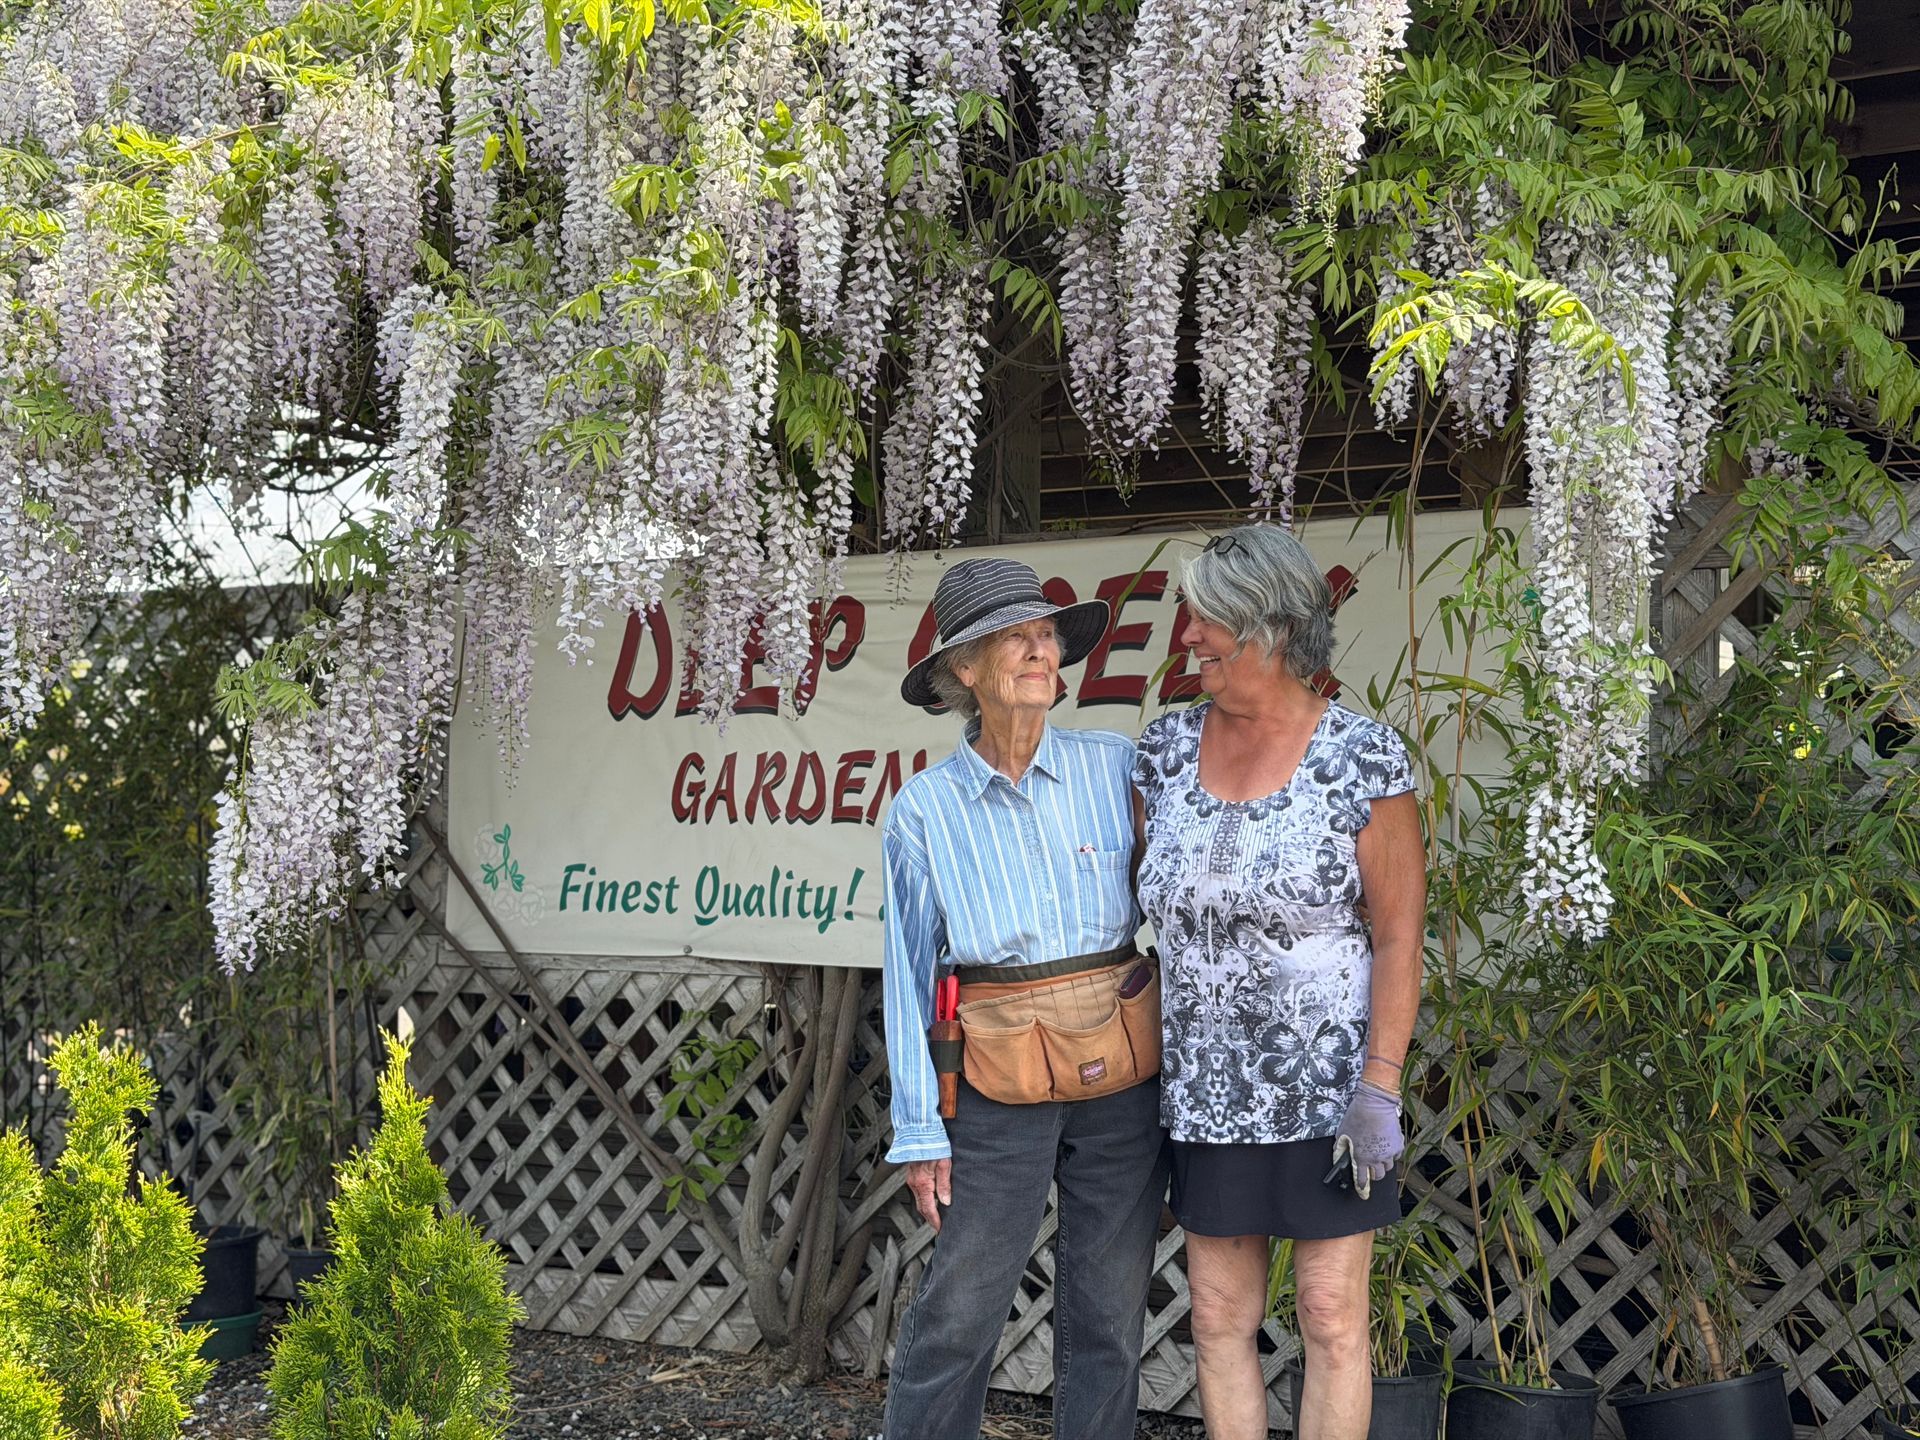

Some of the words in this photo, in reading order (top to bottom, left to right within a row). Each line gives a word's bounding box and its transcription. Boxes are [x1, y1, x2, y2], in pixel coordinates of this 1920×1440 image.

[671, 749, 927, 827] GARDEN
[559, 863, 680, 914] Finest
[694, 865, 865, 934] Quality!
